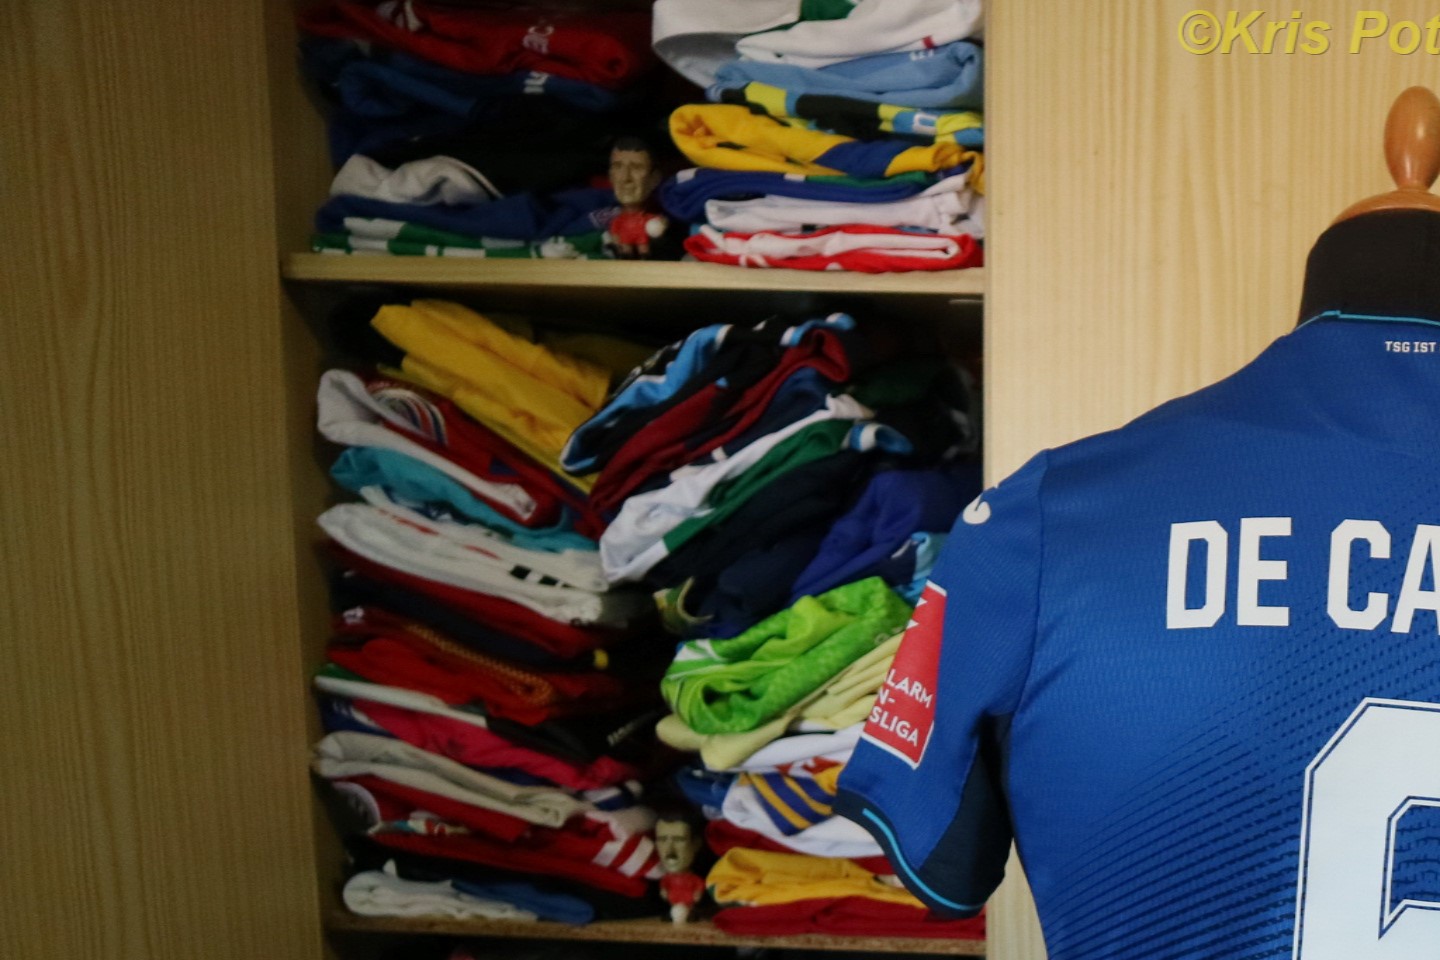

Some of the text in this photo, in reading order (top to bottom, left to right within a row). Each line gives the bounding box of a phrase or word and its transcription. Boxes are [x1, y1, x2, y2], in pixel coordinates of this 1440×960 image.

[1384, 341, 1410, 354] TSG
[1413, 341, 1438, 354] IST
[1166, 516, 1293, 630] DE
[883, 668, 935, 709] LARM
[869, 705, 919, 748] SLIGA
